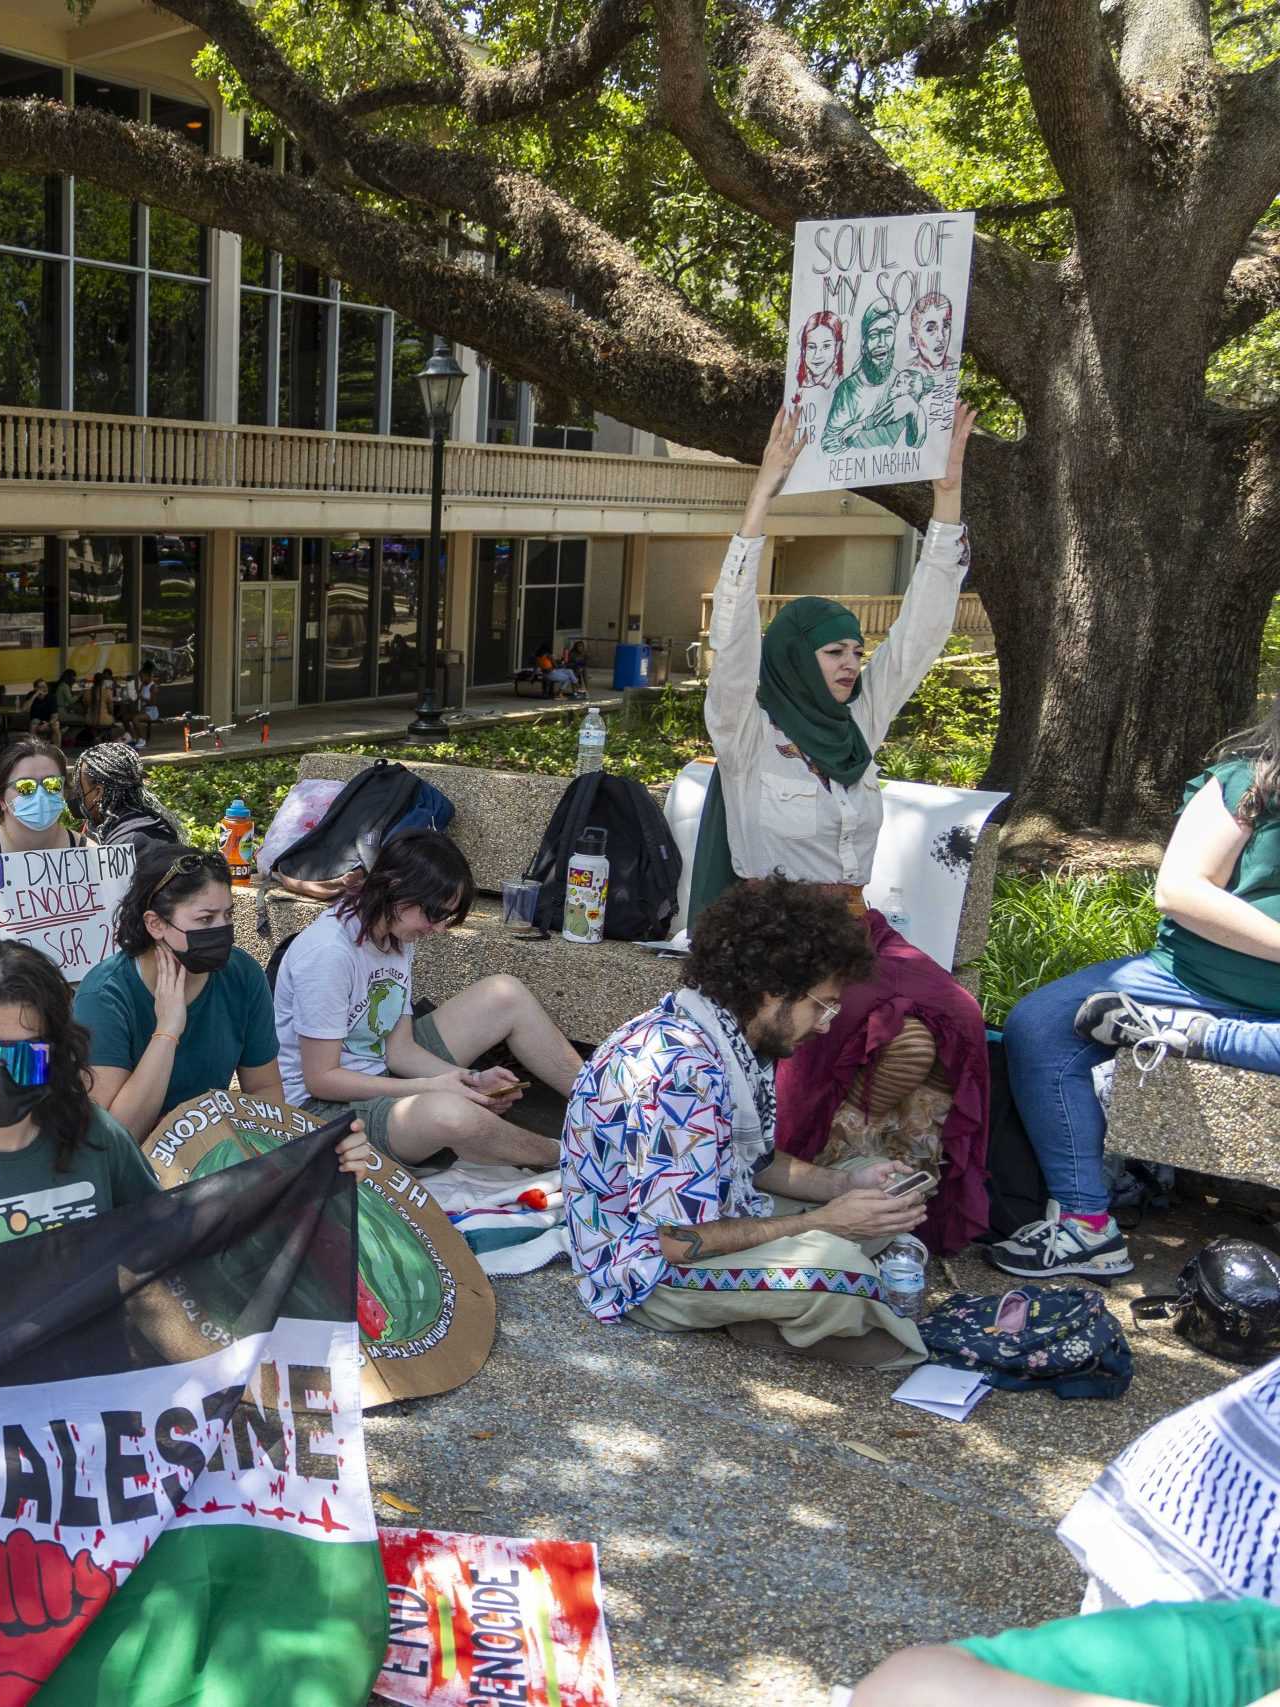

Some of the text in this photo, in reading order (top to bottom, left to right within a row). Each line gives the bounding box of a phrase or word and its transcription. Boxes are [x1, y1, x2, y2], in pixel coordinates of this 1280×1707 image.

[812, 219, 961, 275] SOUL OF
[822, 275, 863, 317] MY
[829, 453, 920, 482] REEM NABHAN
[23, 849, 91, 886] DIVEST
[97, 845, 136, 881] FROM
[150, 1090, 237, 1169] BECOME
[237, 1096, 284, 1124] HAS
[386, 1168, 429, 1209] HE
[381, 1345, 411, 1359] THE
[381, 1584, 429, 1677] END
[465, 1569, 530, 1707] ENOCIDE
